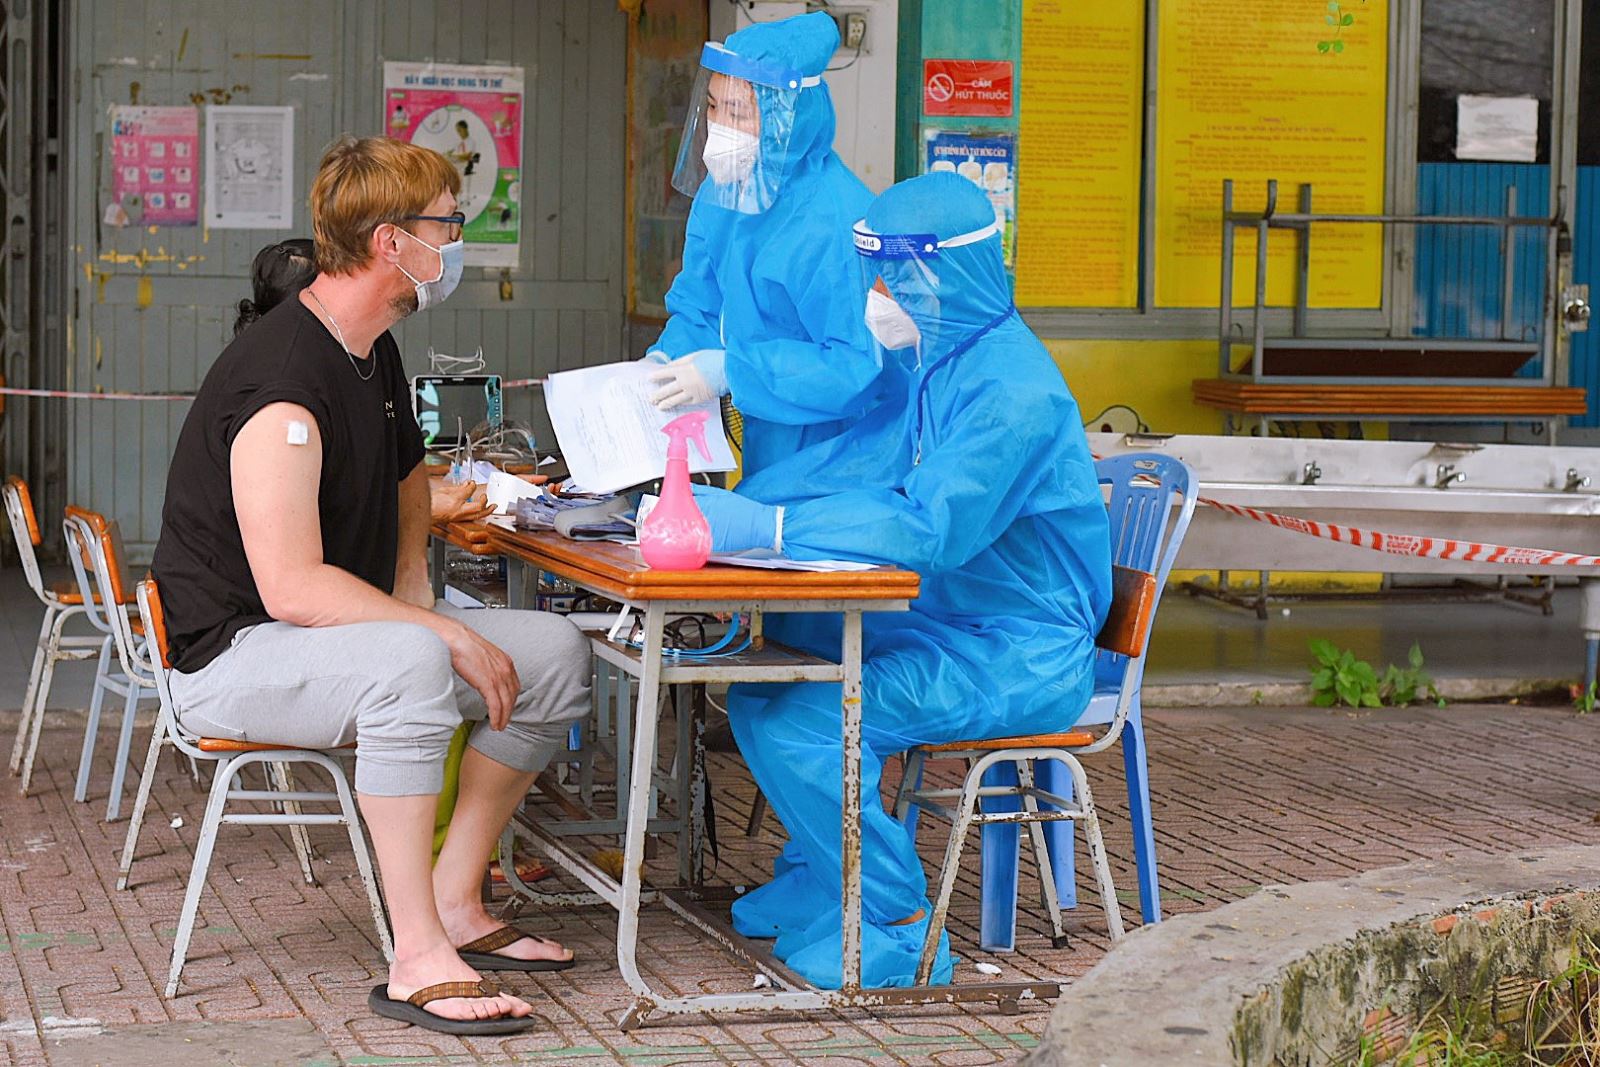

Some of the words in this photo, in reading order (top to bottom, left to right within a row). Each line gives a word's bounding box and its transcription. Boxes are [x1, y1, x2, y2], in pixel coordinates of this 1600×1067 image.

[972, 78, 992, 88] CẤM
[955, 89, 974, 100] HÚT
[976, 89, 1009, 100] THUỐC
[385, 400, 393, 410] N
